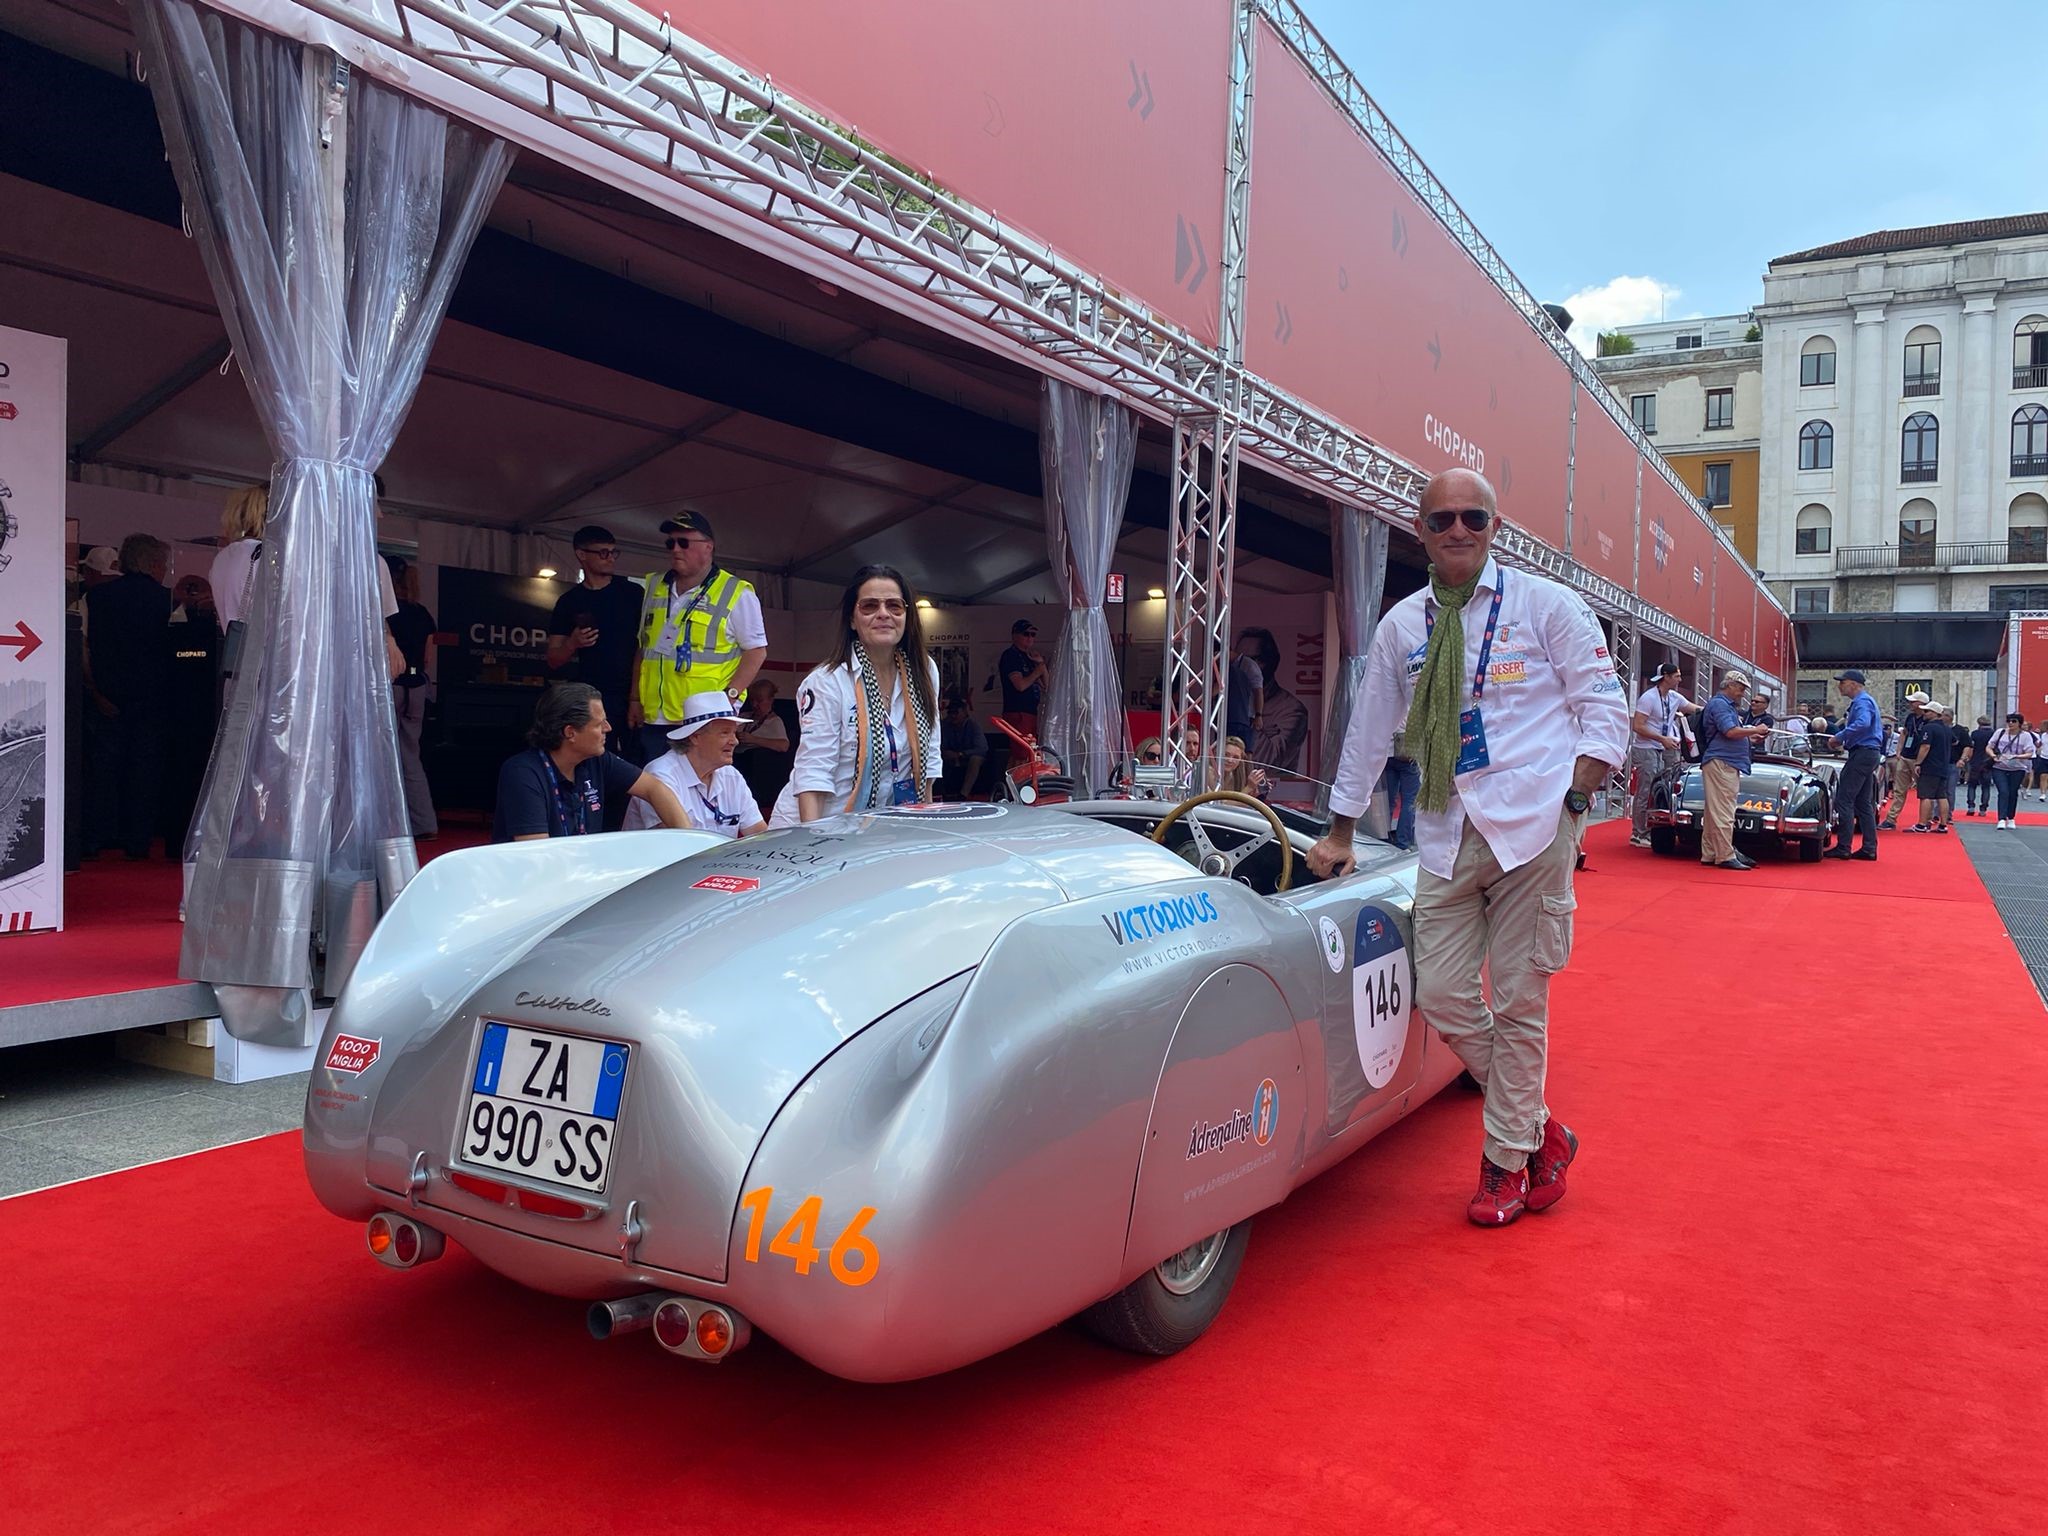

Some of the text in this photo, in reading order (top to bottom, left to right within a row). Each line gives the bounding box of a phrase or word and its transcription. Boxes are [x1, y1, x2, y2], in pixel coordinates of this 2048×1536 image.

[1424, 413, 1485, 474] CHOPARD
[470, 623, 548, 648] CHOP
[1491, 661, 1526, 676] DESERT
[1743, 799, 1773, 812] 443
[699, 882, 738, 891] MIGLIA
[702, 862, 819, 881] OFFICIAL WINE
[712, 877, 743, 886] 1000
[1100, 890, 1218, 946] VICTORIOUS
[1121, 933, 1232, 974] WWW.VICTORIOUS.CH
[1365, 963, 1402, 1029] 146
[329, 1053, 364, 1069] MIGLIA
[340, 1039, 371, 1055] 1000
[521, 1038, 570, 1102] ZA
[469, 1100, 608, 1183] 990 SS
[1185, 1108, 1253, 1161] Adrenaline
[741, 1185, 880, 1287] 146
